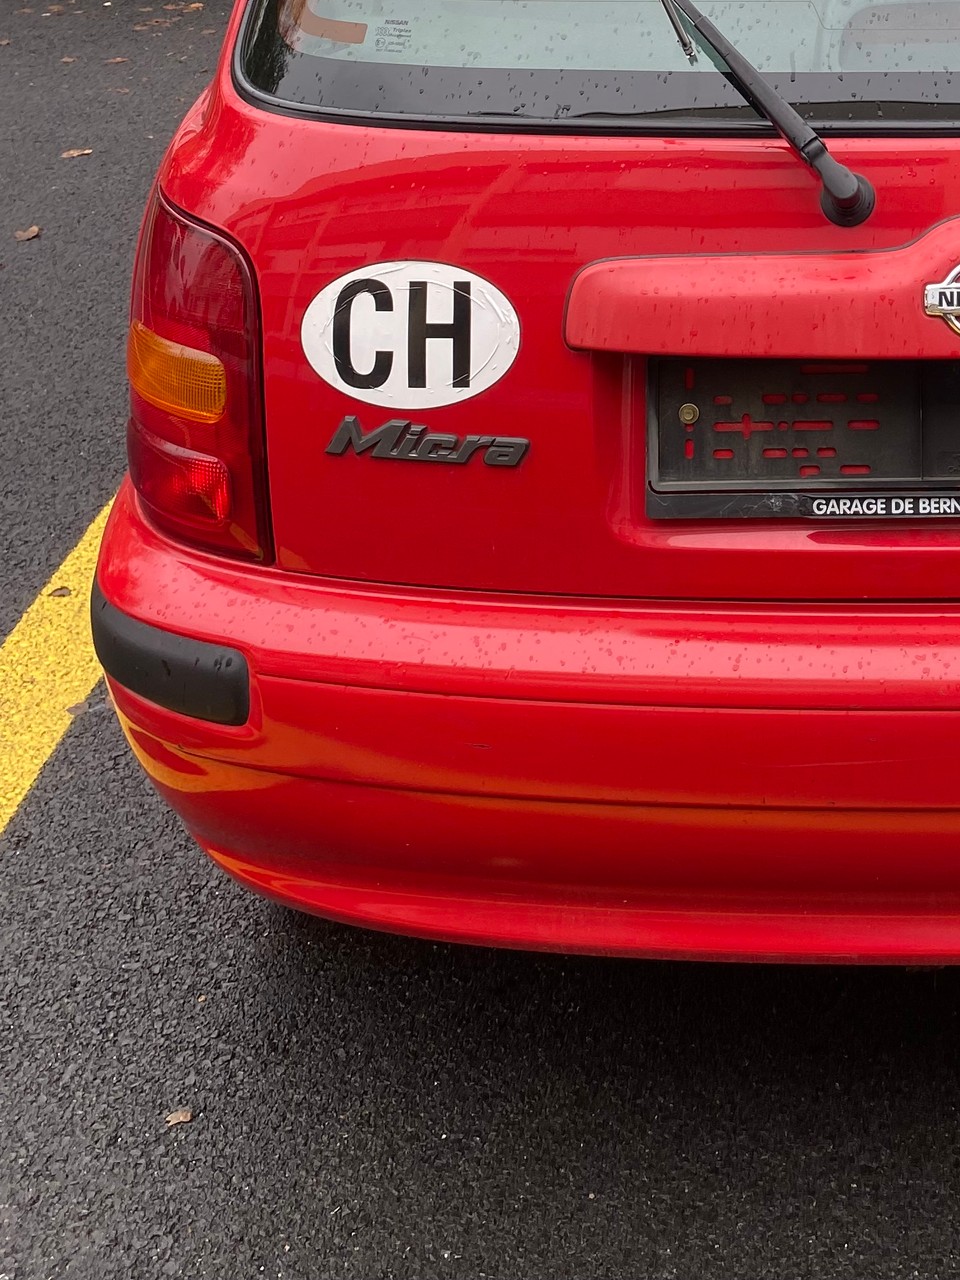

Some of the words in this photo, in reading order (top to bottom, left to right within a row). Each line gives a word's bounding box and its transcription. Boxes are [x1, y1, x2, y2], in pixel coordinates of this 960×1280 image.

[333, 278, 471, 389] CH
[324, 415, 530, 466] Micra
[812, 498, 886, 515] GARAGE
[891, 498, 914, 514] DE
